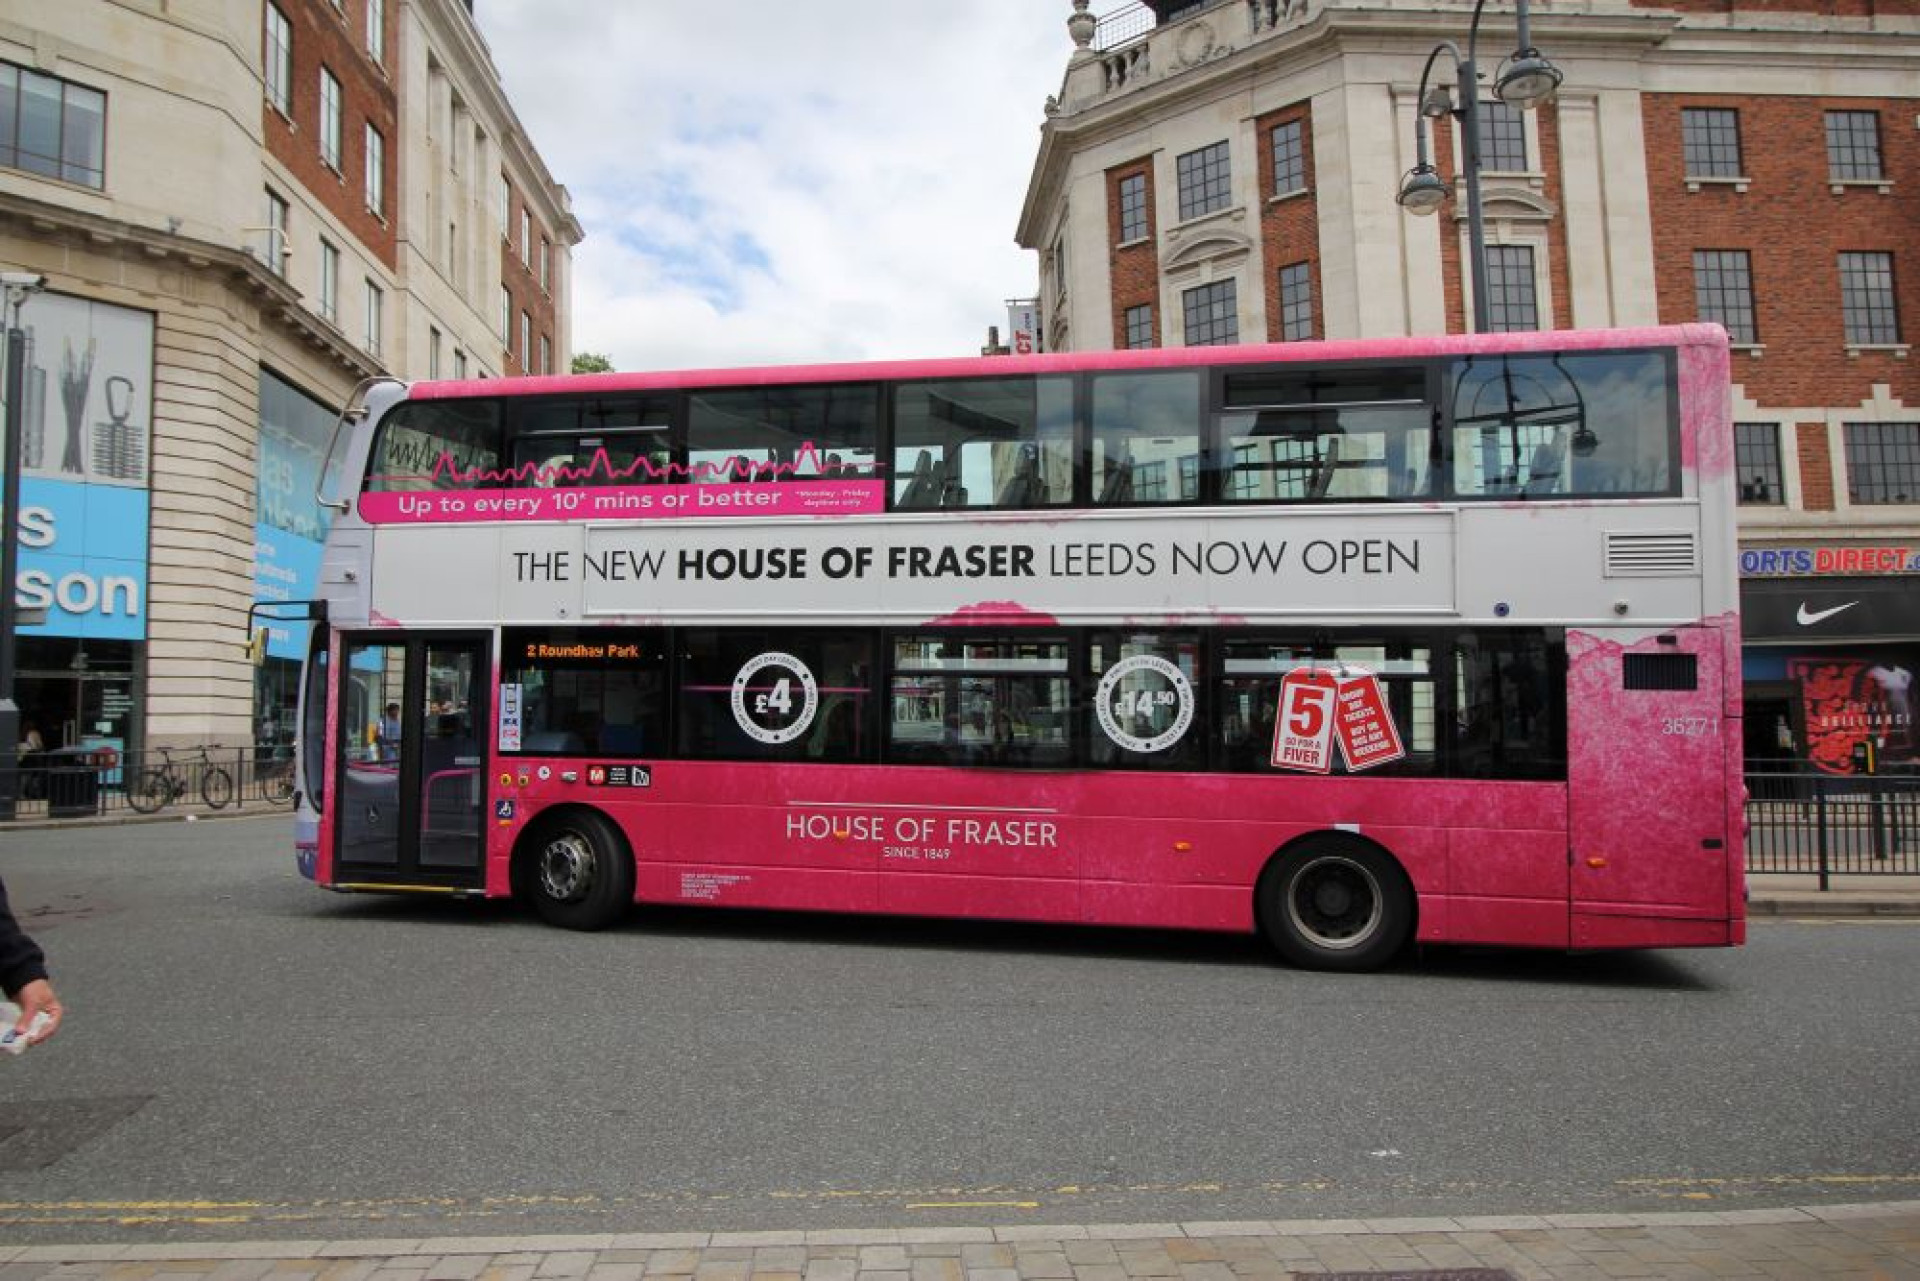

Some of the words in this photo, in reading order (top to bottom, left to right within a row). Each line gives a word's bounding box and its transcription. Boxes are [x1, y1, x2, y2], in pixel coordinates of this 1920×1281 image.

[398, 496, 431, 517] Up
[440, 497, 465, 512] to
[473, 497, 542, 516] every
[595, 491, 653, 509] mins
[662, 494, 690, 508] or
[698, 487, 782, 506] better
[18, 506, 56, 548] s
[513, 551, 570, 581] THE
[584, 549, 666, 581] NEW
[677, 547, 807, 581] HOUSE
[820, 546, 873, 580] OF
[887, 545, 1035, 579] FRASER
[1050, 542, 1156, 577] LEEDS
[1172, 540, 1287, 576] NOW
[1302, 538, 1419, 575] OPEN
[15, 570, 138, 615] son
[527, 644, 536, 658] 2
[539, 644, 604, 658] Roundhay
[608, 644, 638, 658] Park
[755, 678, 791, 714] £4
[1290, 687, 1325, 737] 5
[1662, 717, 1718, 736] 36271
[1284, 747, 1320, 764] FIVER
[786, 814, 884, 841] HOUSE
[895, 817, 937, 842] OF
[947, 819, 1057, 847] FRASER
[883, 846, 920, 859] SINCE
[923, 848, 951, 859] 1849
